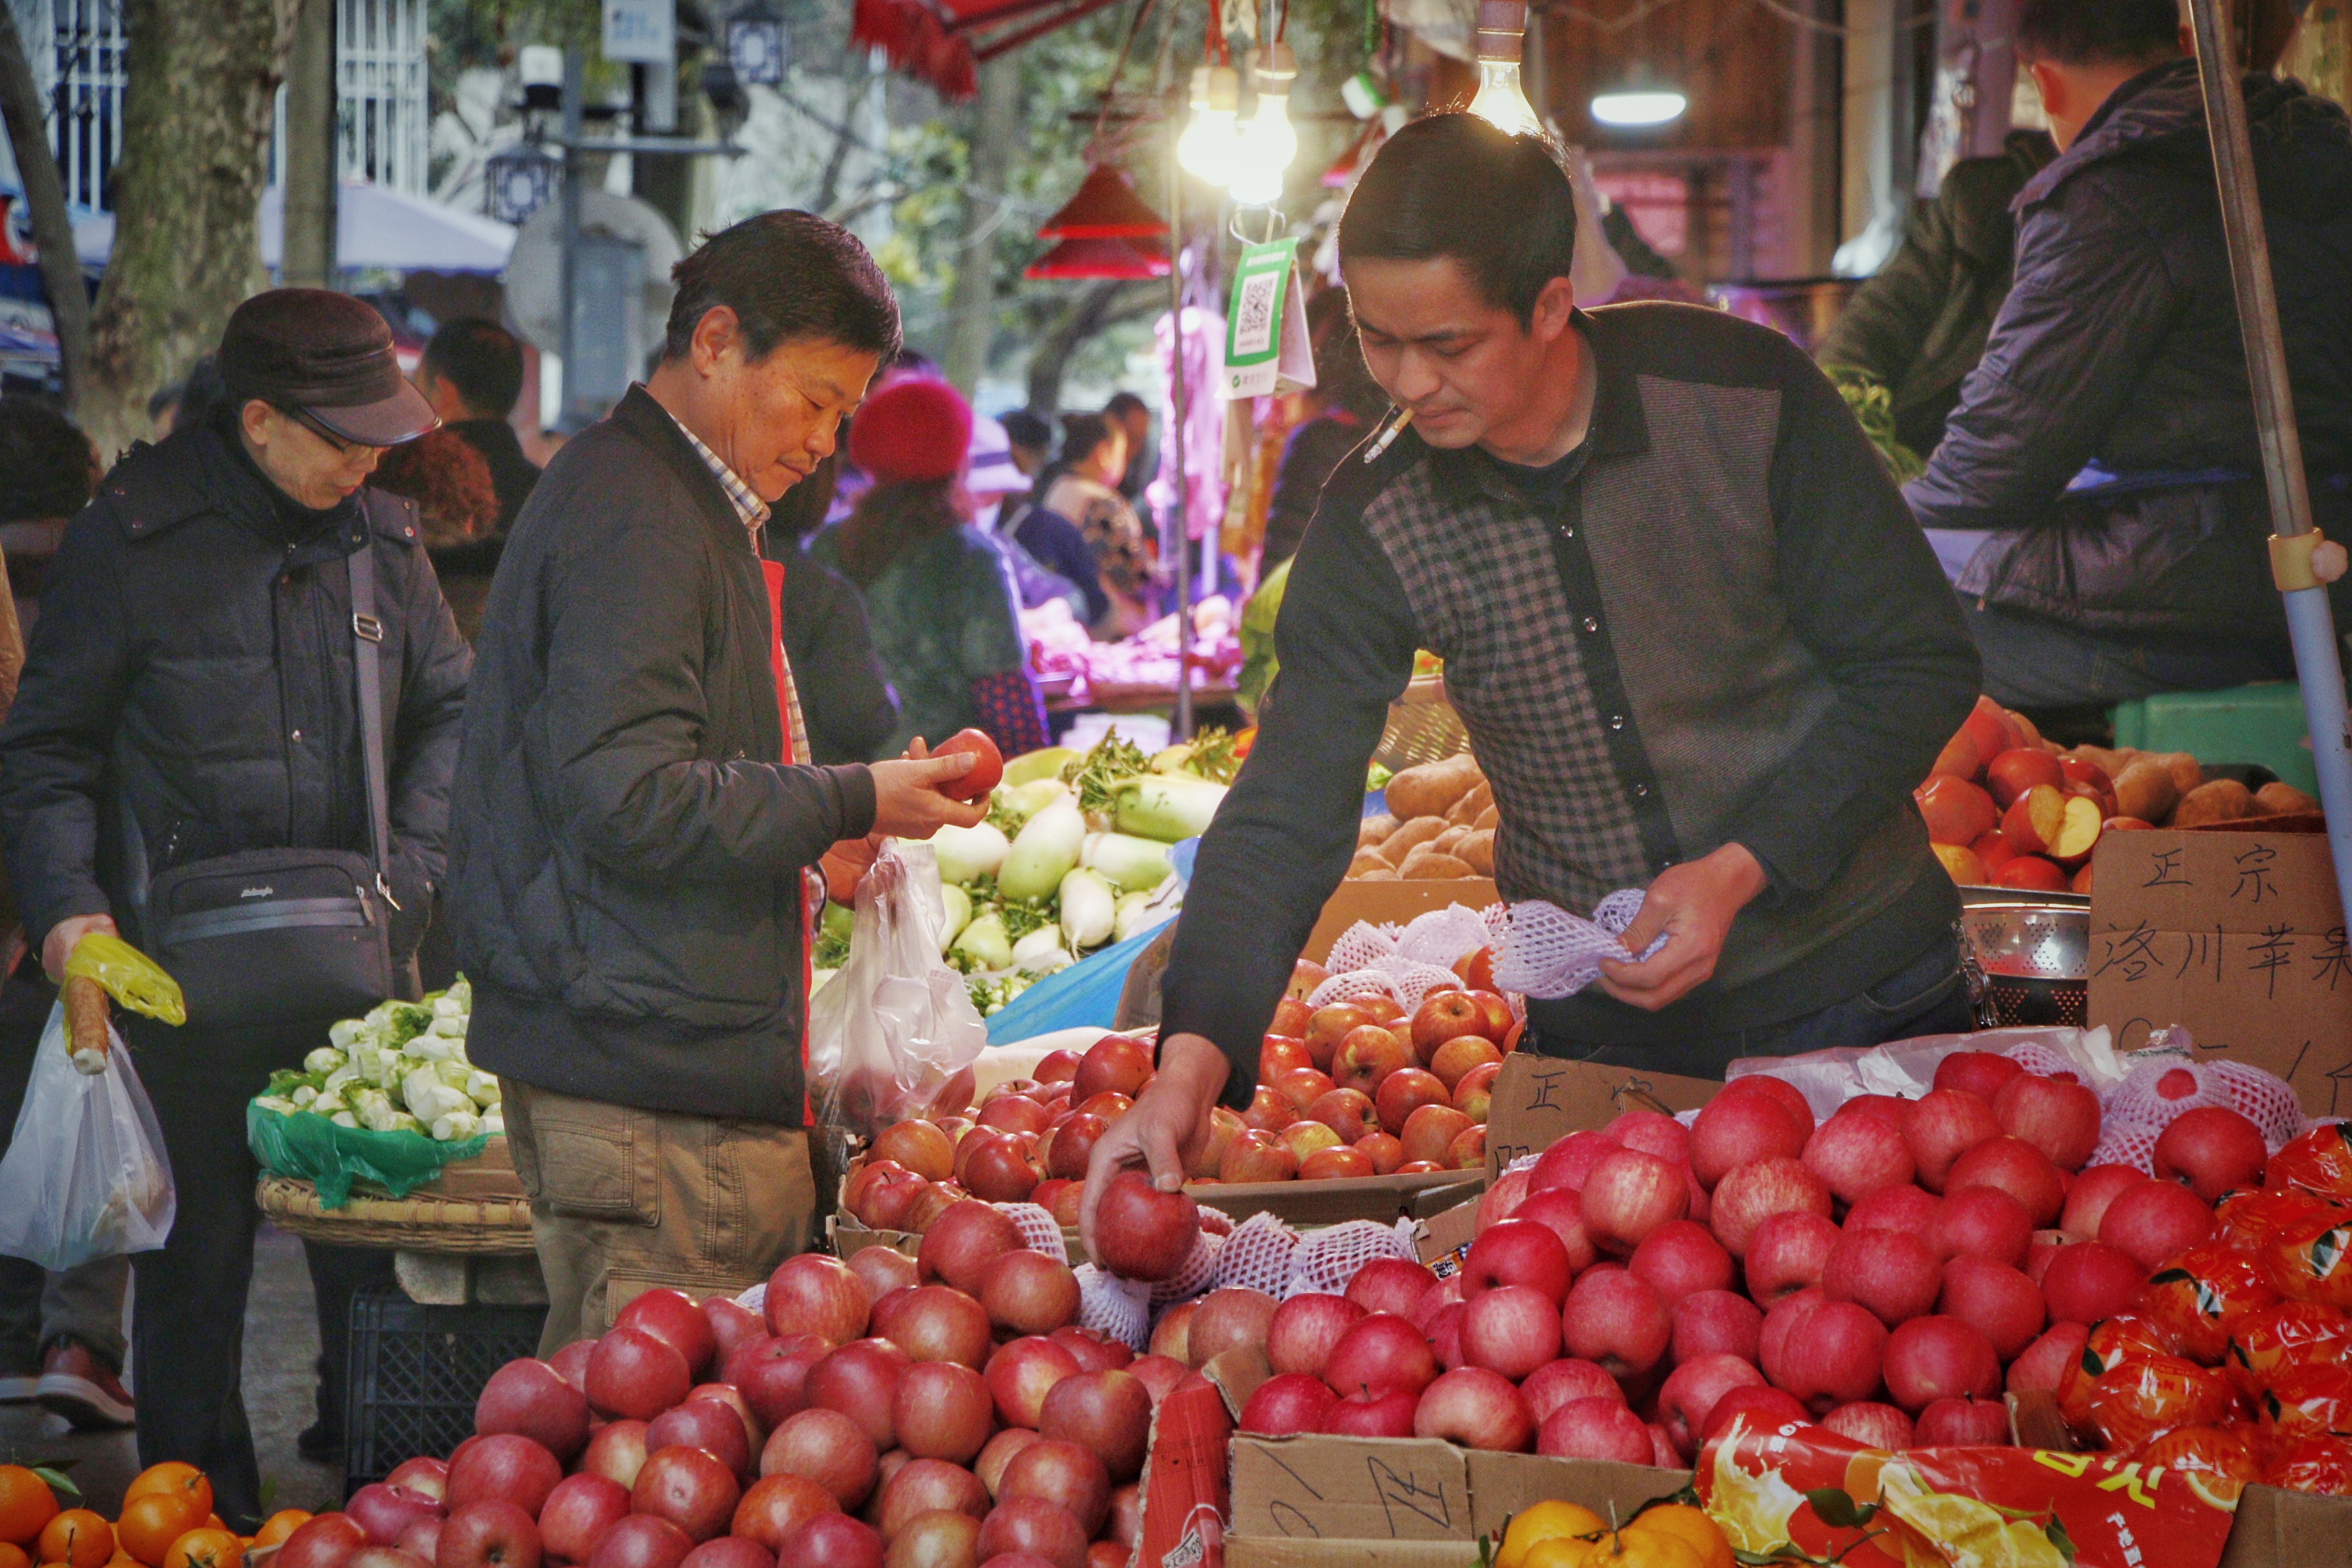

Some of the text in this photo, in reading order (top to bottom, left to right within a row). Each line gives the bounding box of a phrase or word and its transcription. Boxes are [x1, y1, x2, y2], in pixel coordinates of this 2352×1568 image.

[2142, 844, 2277, 903] 正宗
[2094, 919, 2351, 999] 洛川苹果
